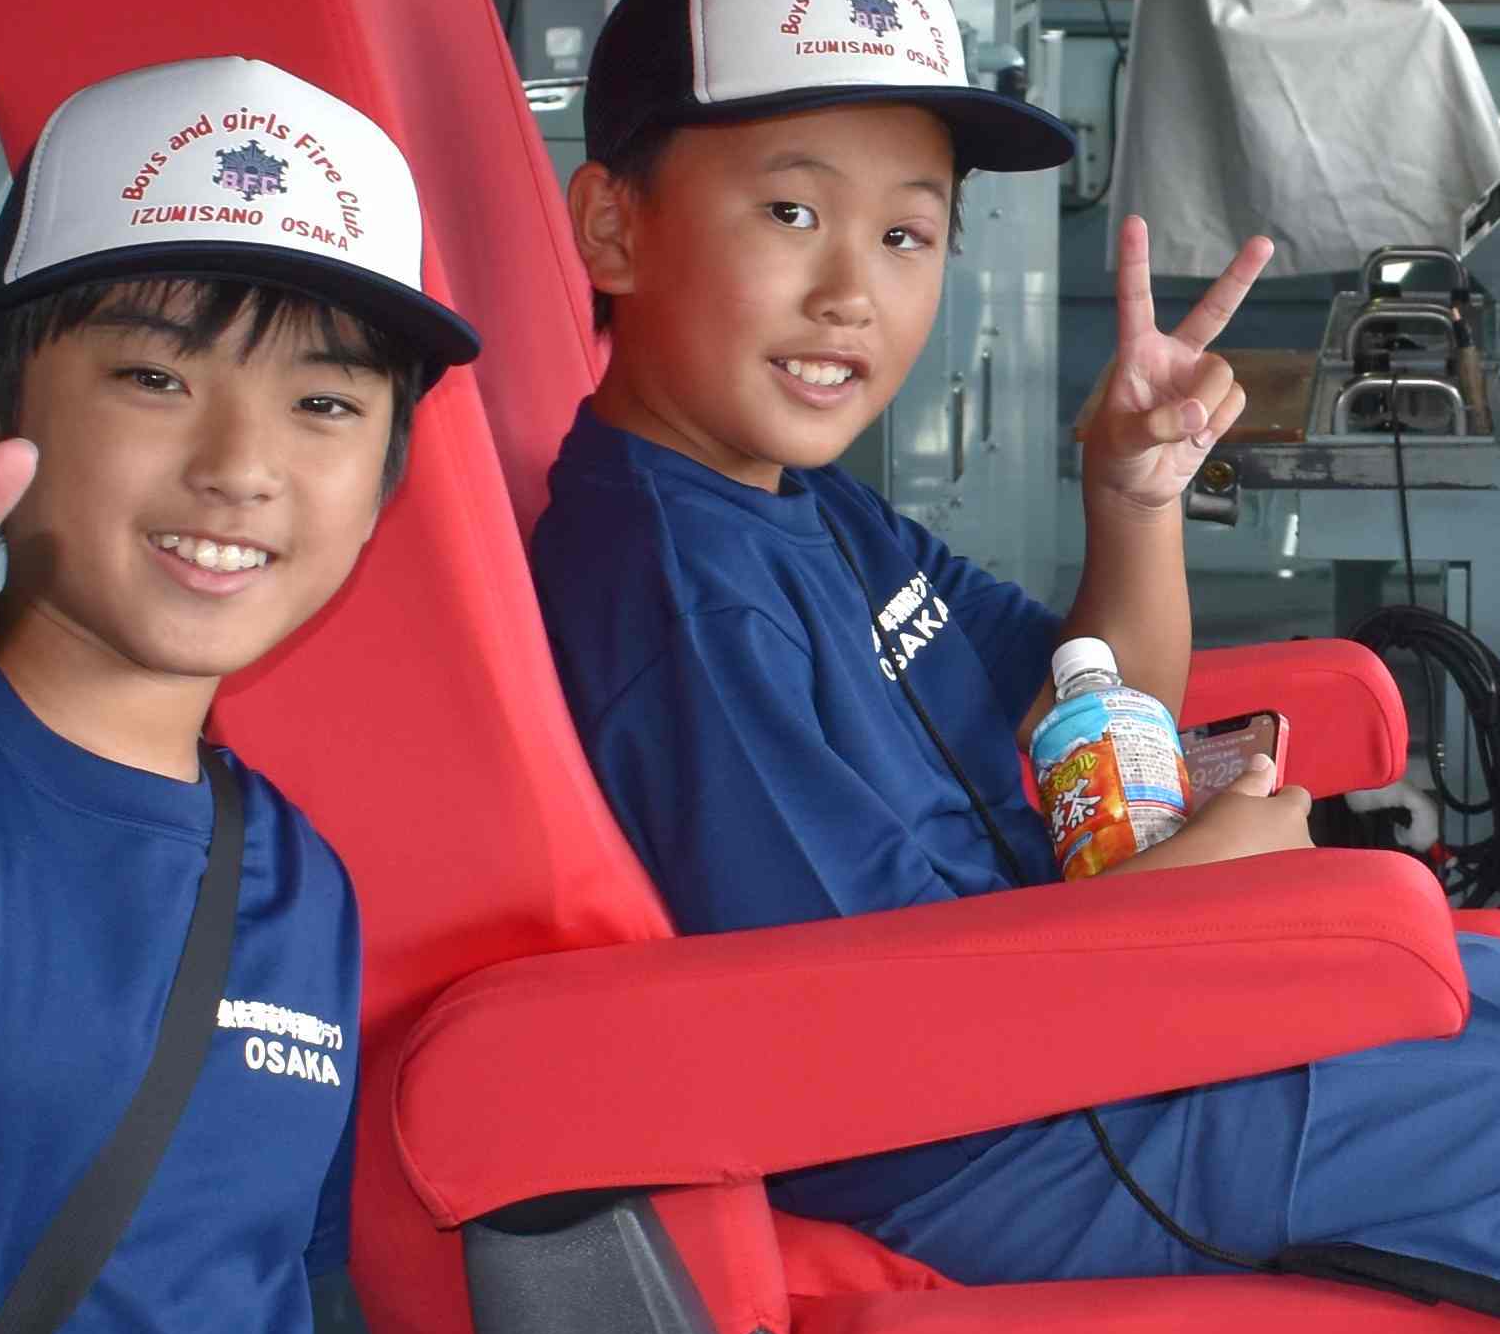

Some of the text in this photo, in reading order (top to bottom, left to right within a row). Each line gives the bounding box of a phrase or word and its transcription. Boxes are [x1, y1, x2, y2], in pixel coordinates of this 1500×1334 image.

[796, 41, 895, 56] IZUMISANO
[122, 107, 364, 239] Boys and girls Fire Club
[131, 205, 349, 251] IZUMISANO OSAKA
[245, 1036, 341, 1086] OSAKA
